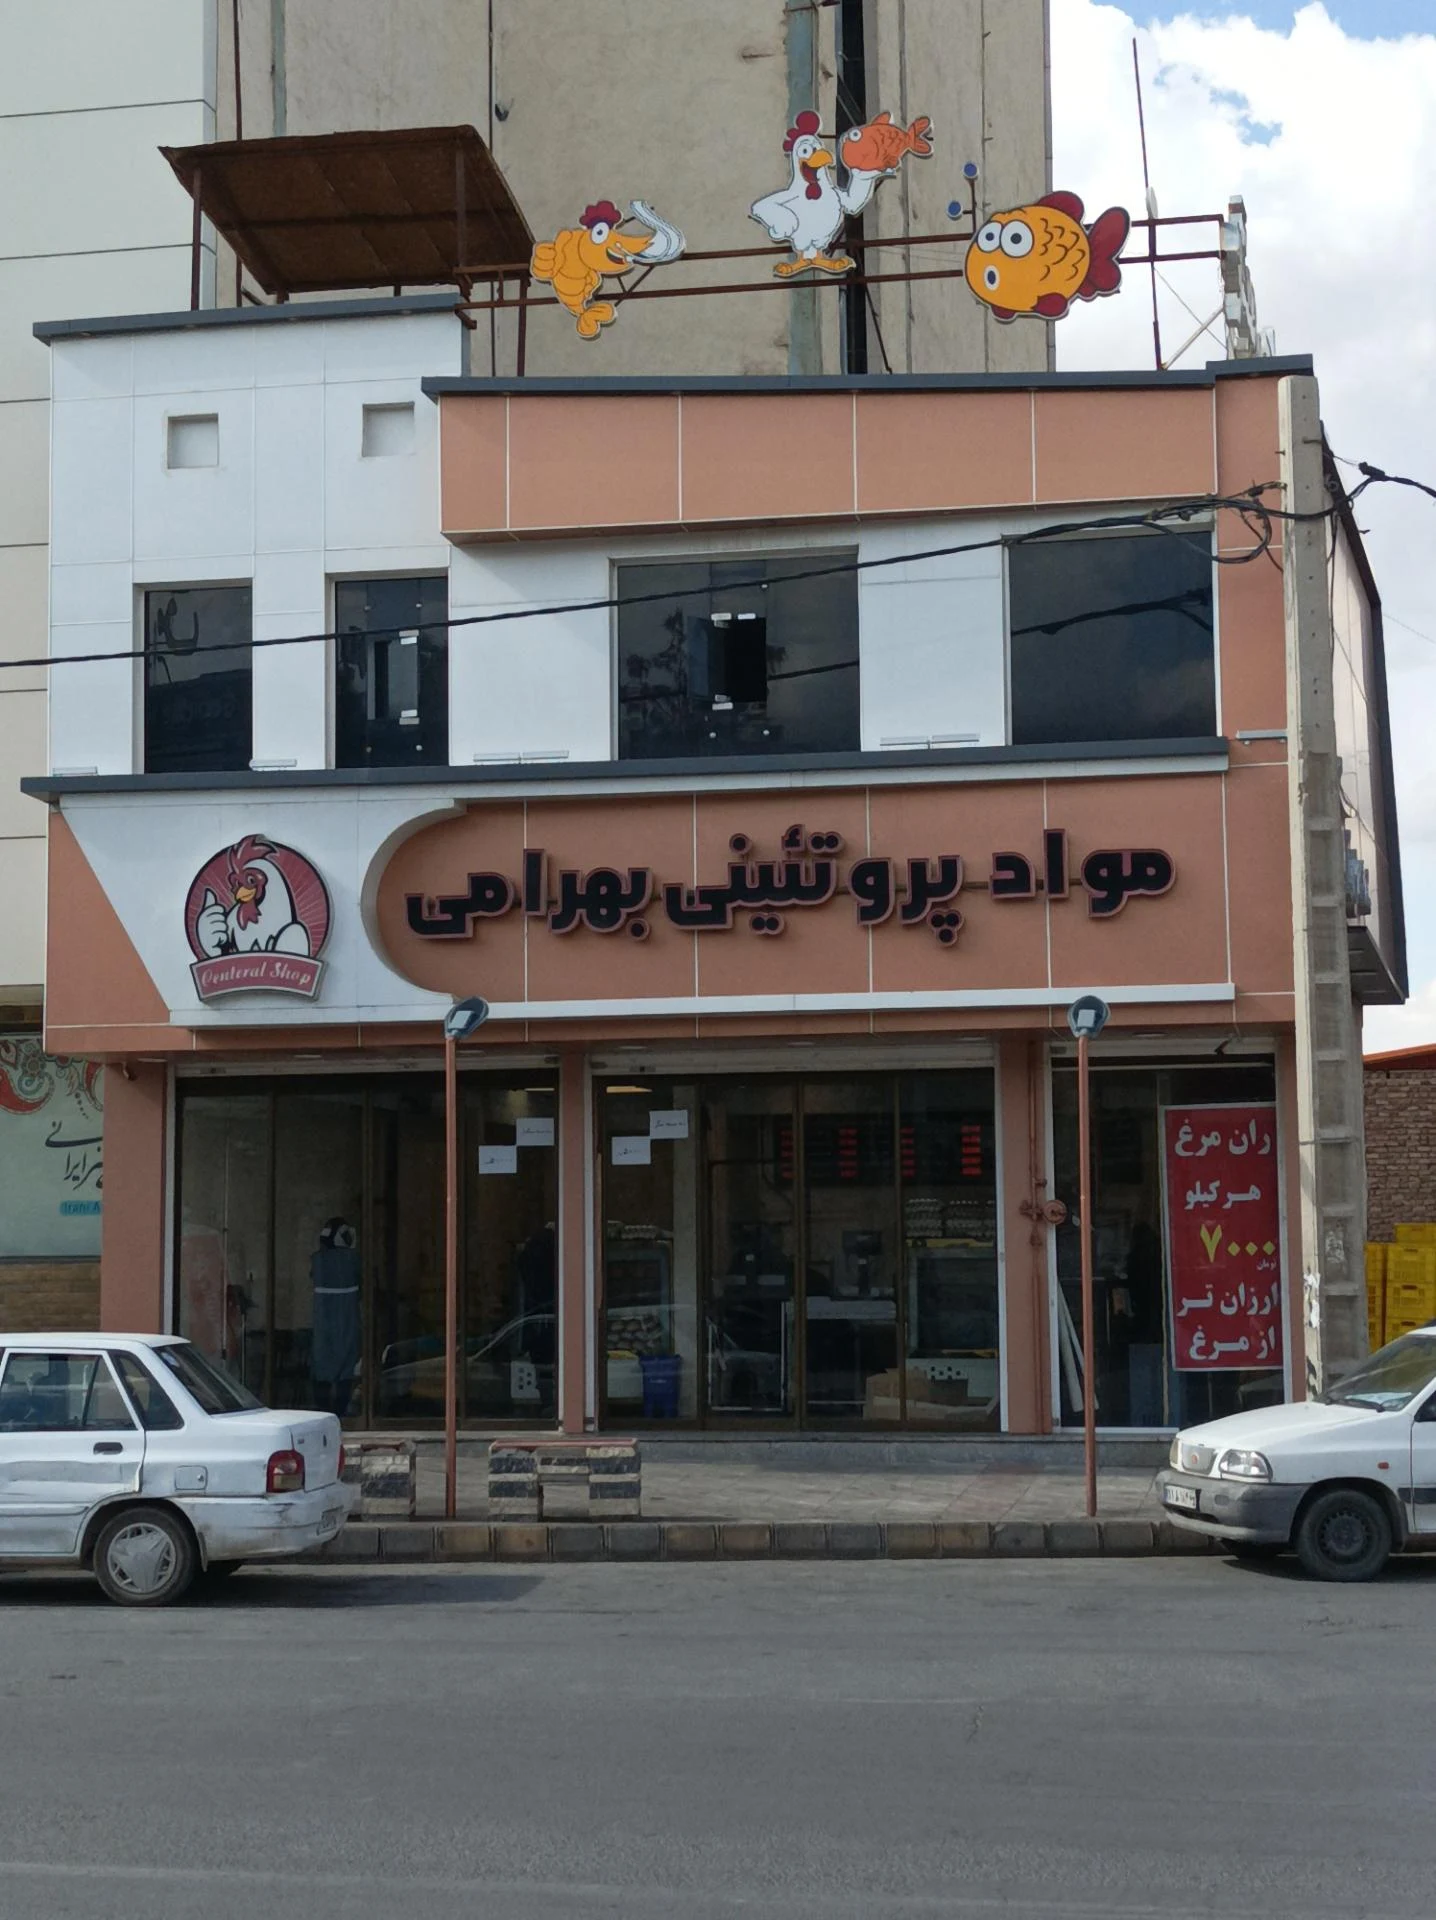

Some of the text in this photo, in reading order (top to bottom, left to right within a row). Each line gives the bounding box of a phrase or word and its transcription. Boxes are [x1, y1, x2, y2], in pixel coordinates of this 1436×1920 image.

[405, 824, 1177, 947] مواد پروتئینی بهرامی
[269, 961, 312, 985] Shop
[1174, 1118, 1272, 1157] ران مرغ
[1184, 1180, 1262, 1210] هر کیلو
[1175, 1281, 1280, 1317] ارزان تر
[1188, 1324, 1276, 1361] از مرغ
